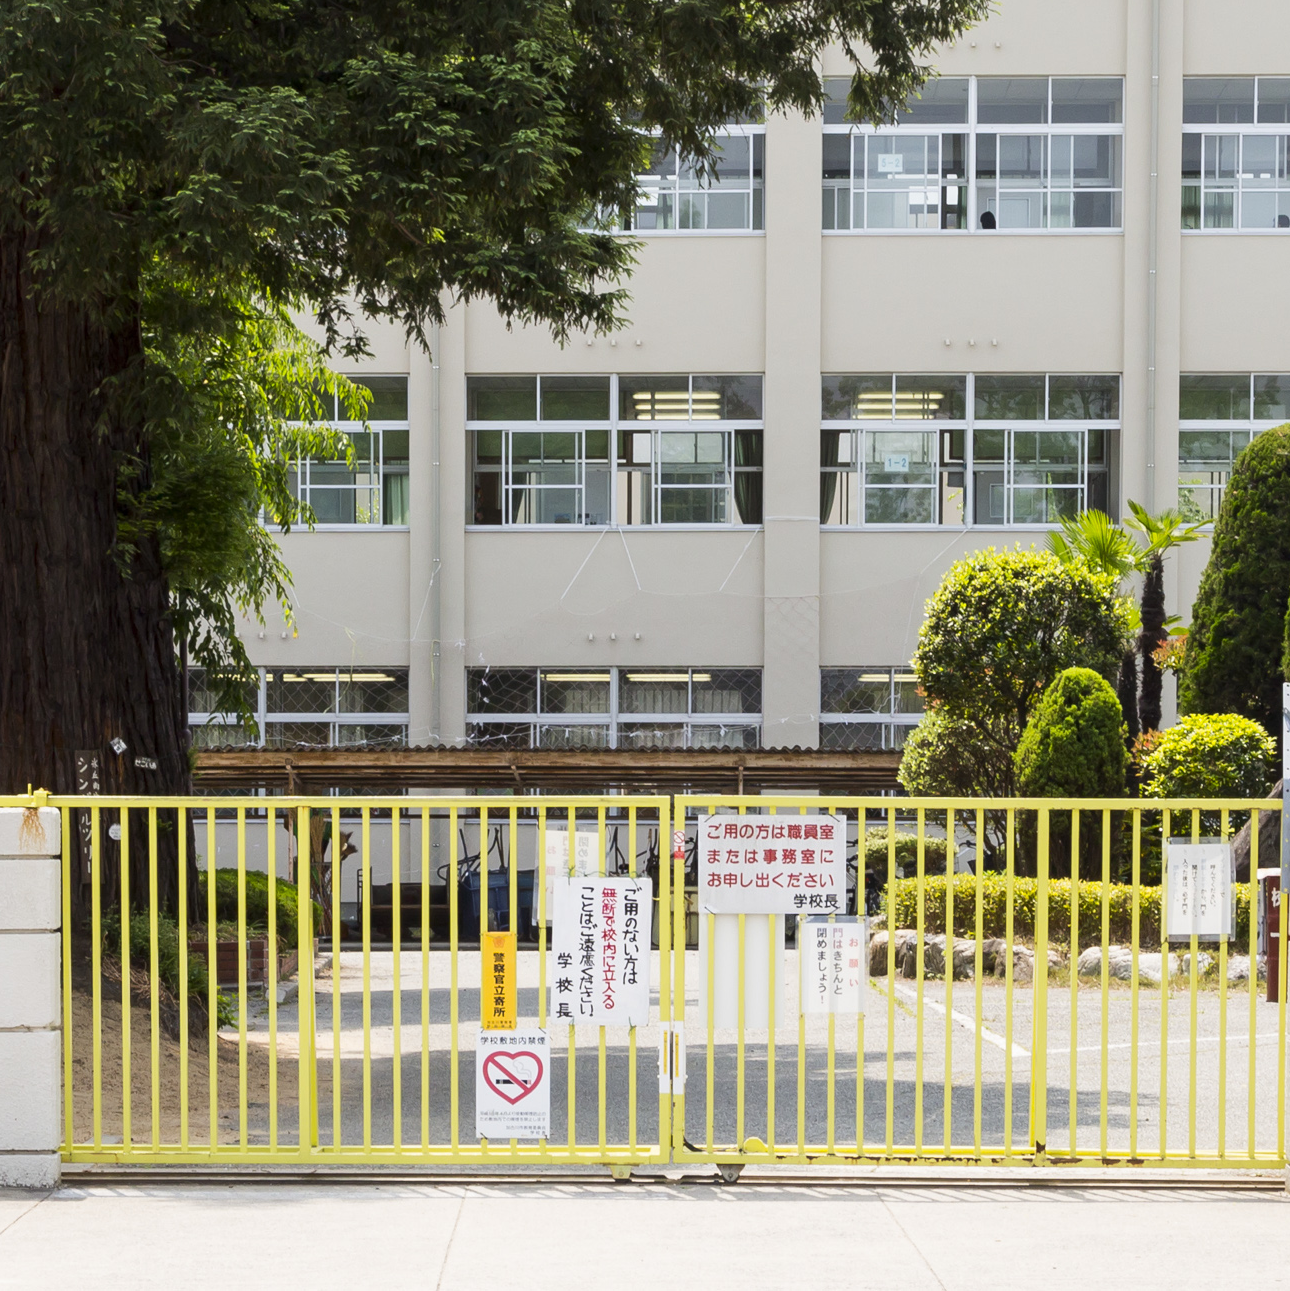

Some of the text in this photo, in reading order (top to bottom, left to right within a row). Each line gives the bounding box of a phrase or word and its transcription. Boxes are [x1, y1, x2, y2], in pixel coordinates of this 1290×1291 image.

[888, 457, 907, 468] 1-2
[707, 823, 834, 840] ご用の方は職員室
[707, 849, 834, 865] または事務室に
[707, 872, 834, 888] お申し出ください
[793, 893, 839, 909] 学校長
[601, 887, 617, 1010] 無断で校内に立入る
[622, 887, 643, 985] ご用のない方は
[832, 927, 843, 995] 門はきちんと
[849, 938, 859, 987] お願い
[493, 952, 505, 1017] 警察官立寄所
[556, 952, 573, 1019] 学校長
[480, 1036, 546, 1046] 学校敷地内禁煙
